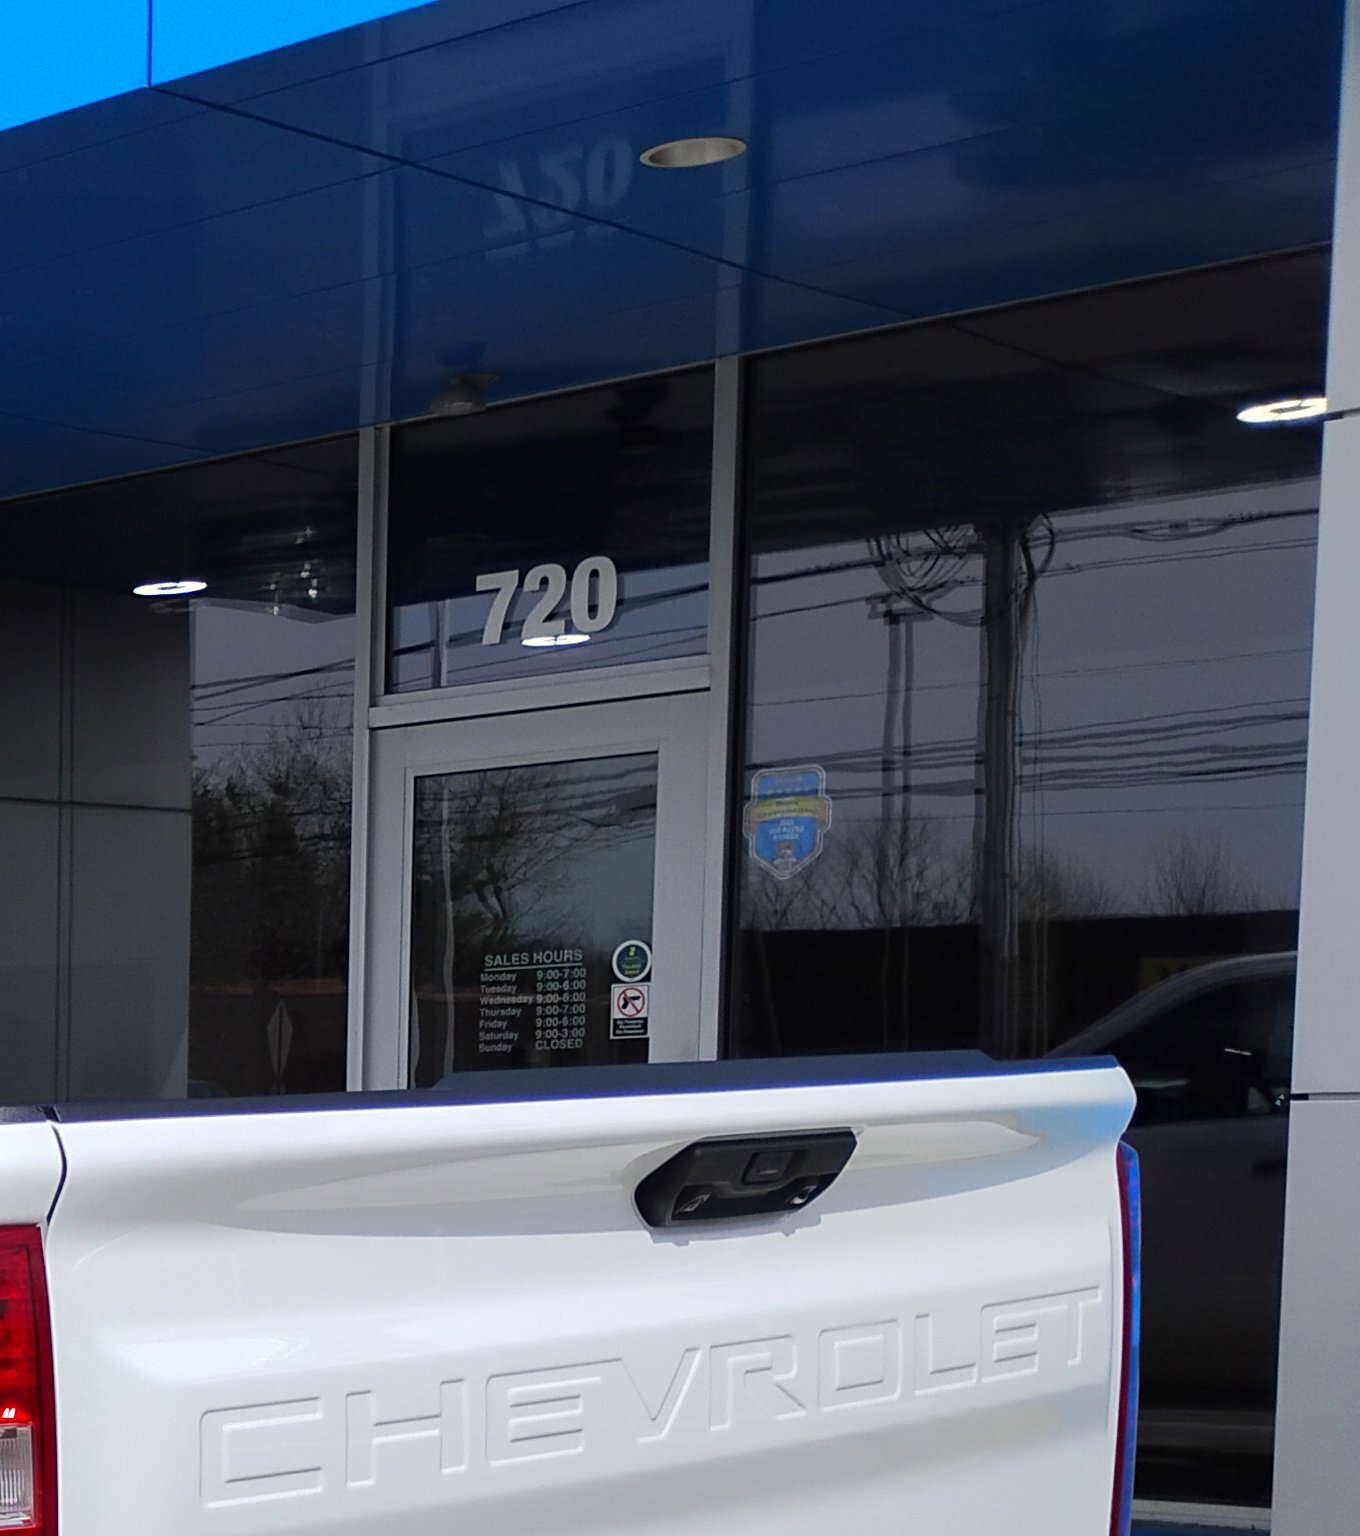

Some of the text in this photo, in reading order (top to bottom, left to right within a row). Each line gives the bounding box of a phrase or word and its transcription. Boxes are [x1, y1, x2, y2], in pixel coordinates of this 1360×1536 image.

[475, 555, 618, 647] 720
[484, 949, 583, 967] SALES HOURS
[480, 967, 587, 982] Monday 9:00-7:00
[480, 979, 587, 994] Tuesday 9:00-6:00
[480, 991, 586, 1005] Wednesday 9:00-6:00
[479, 1004, 586, 1017] Thursday 9:00-7:00
[479, 1016, 586, 1029] Friday 9:00-6:00
[479, 1028, 586, 1041] Saturday 9:00-3:00
[479, 1038, 584, 1053] Sunday CLOSED
[198, 1284, 1101, 1509] CHEVROLET
